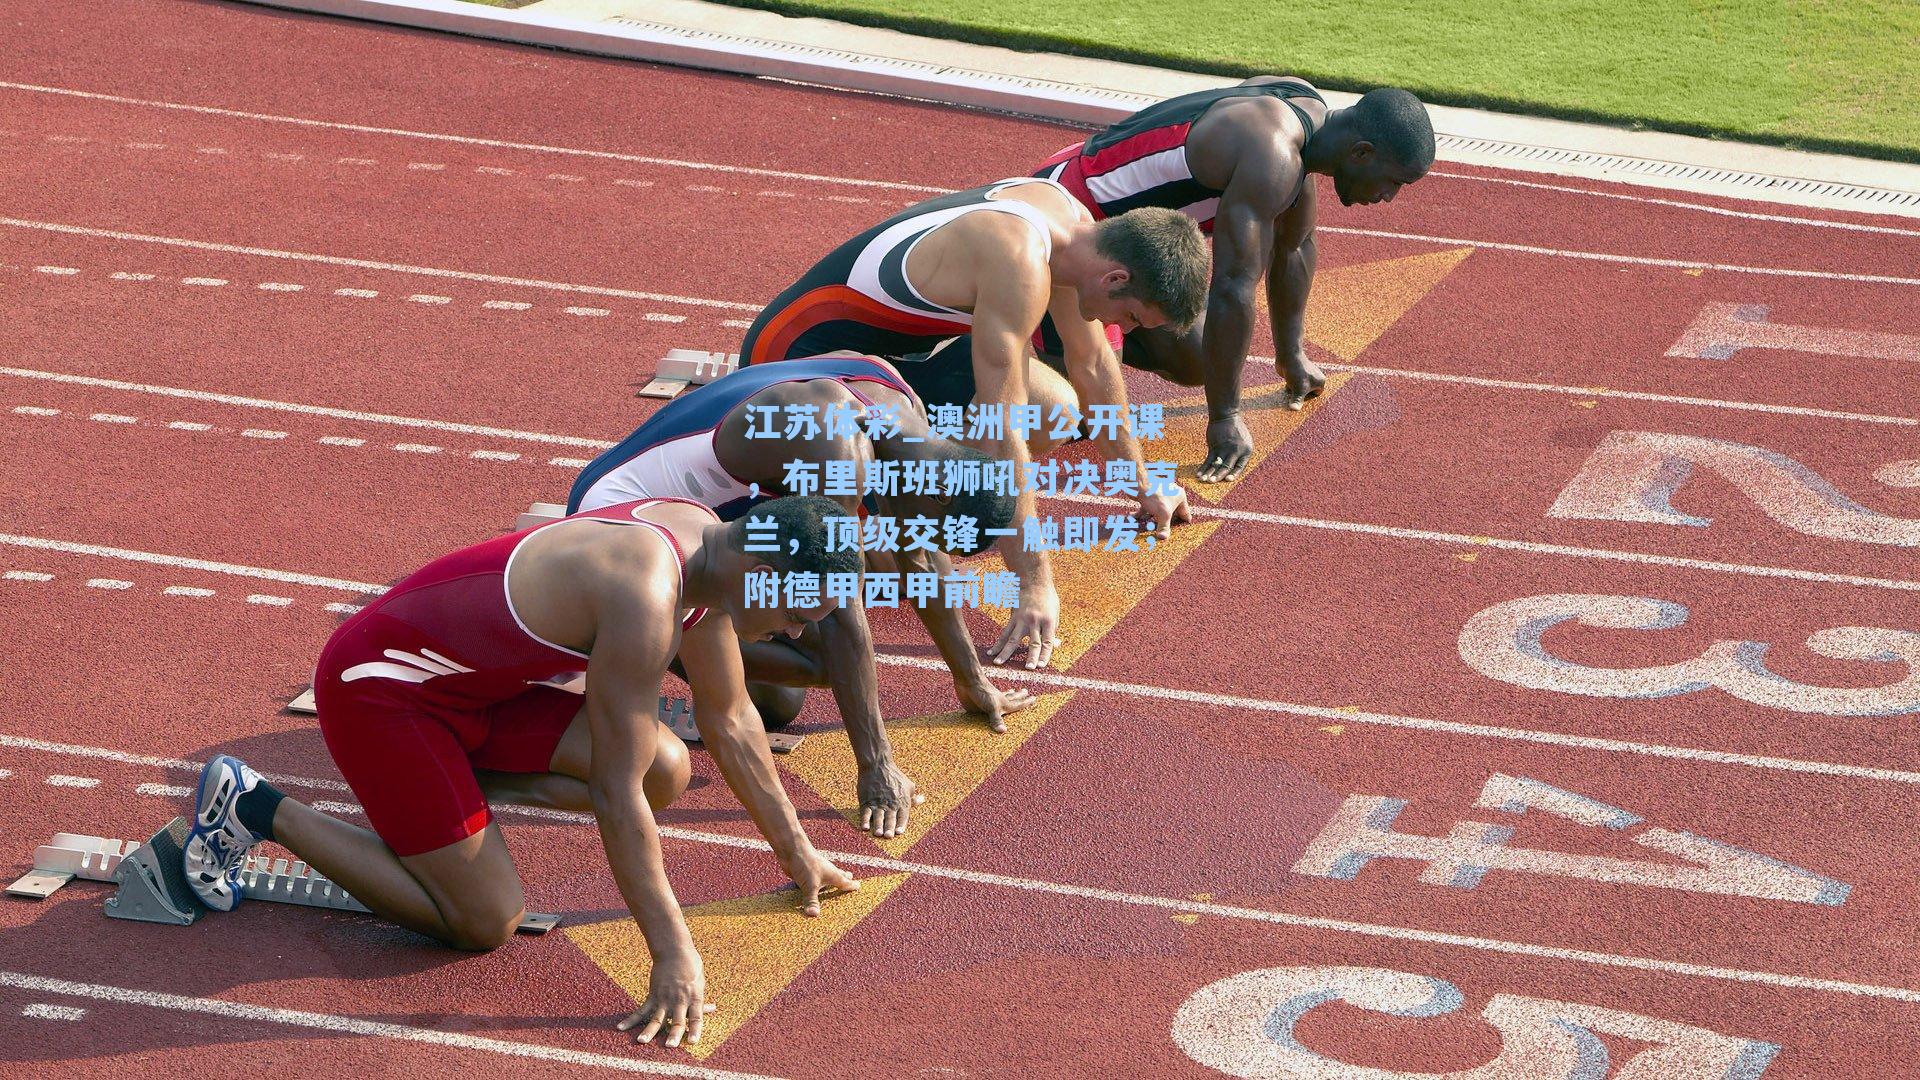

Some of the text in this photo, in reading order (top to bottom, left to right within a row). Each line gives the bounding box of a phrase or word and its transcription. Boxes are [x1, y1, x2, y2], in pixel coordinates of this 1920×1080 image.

[1664, 301, 1920, 361] 1
[1547, 430, 1920, 547] 2
[1457, 593, 1920, 717] 3
[1290, 772, 1853, 906] 4
[1171, 965, 1783, 1080] 5
